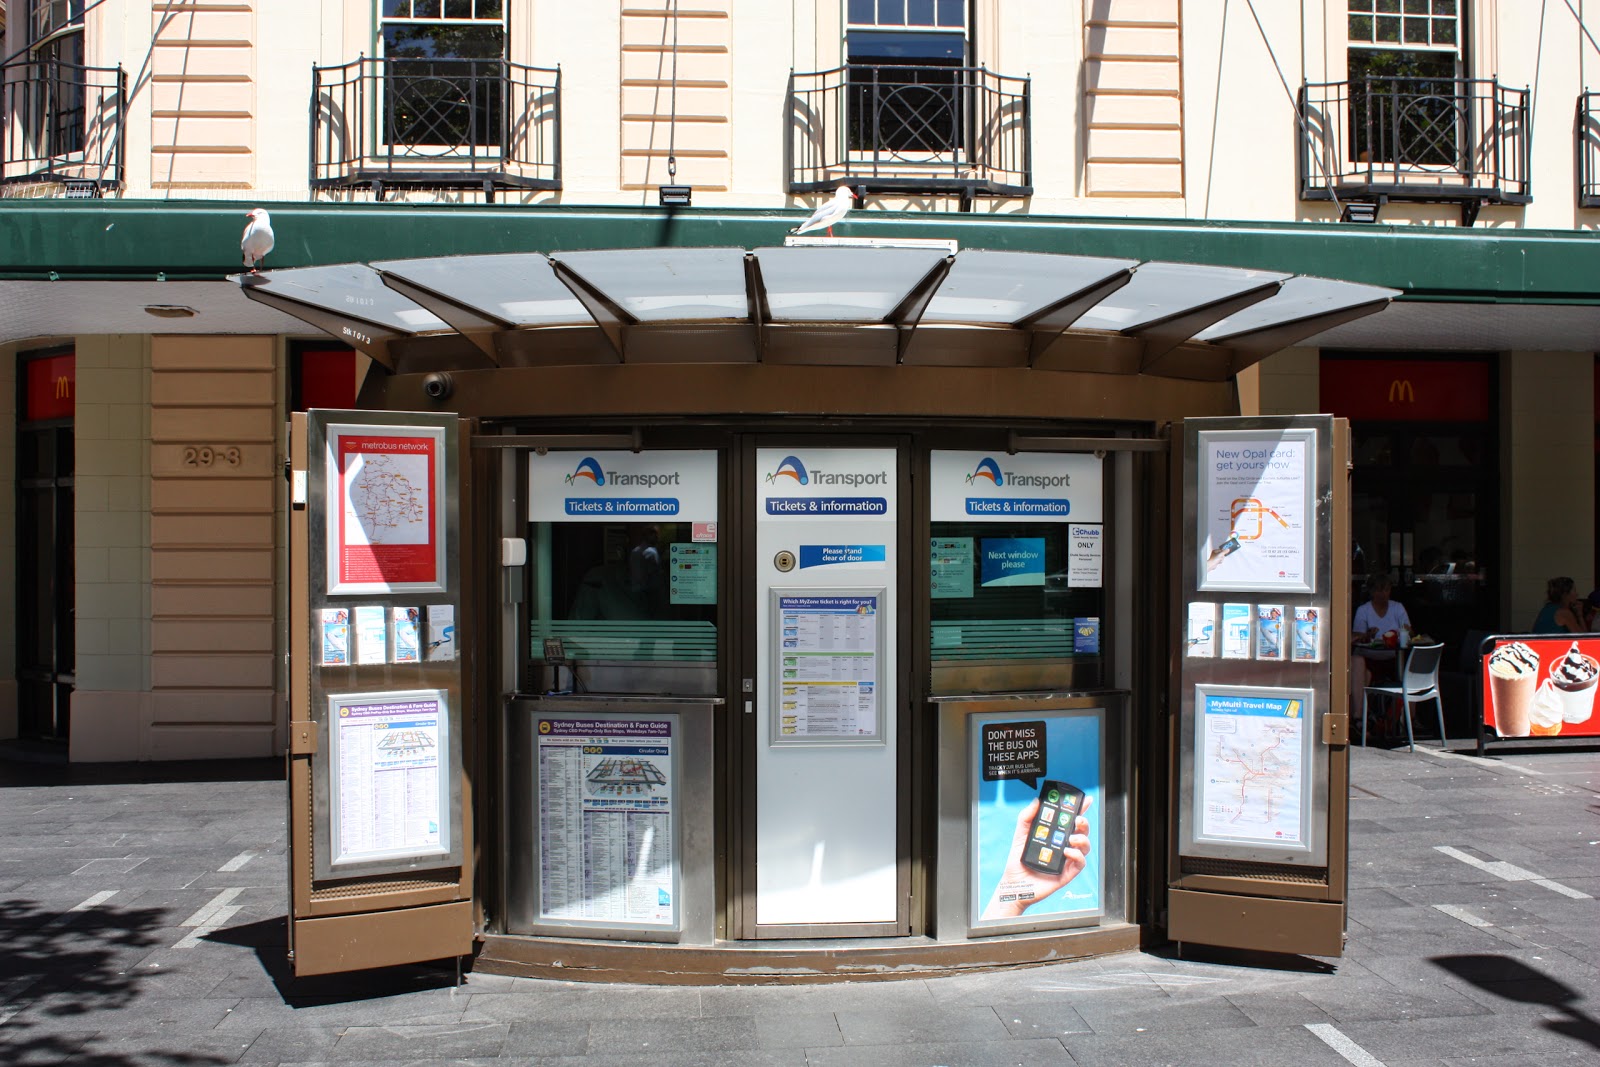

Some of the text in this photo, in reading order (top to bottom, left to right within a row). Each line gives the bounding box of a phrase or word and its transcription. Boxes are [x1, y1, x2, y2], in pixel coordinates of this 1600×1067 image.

[342, 326, 371, 344] Stk 1013
[362, 442, 397, 450] metrobus
[1216, 449, 1295, 459] New Opal card:
[1216, 461, 1233, 471] get
[1237, 462, 1264, 470] yours
[606, 472, 680, 488] Transport
[810, 470, 887, 488] Transport
[1004, 472, 1070, 489] Transport
[569, 501, 676, 512] Tickets & information
[770, 501, 883, 512] Tickets & information
[970, 502, 1067, 513] Tickets & information
[1002, 560, 1025, 570] please
[988, 729, 1035, 740] DON'T MISS
[988, 740, 1038, 751] THE BUS ON
[988, 751, 1039, 762] THESE APPS
